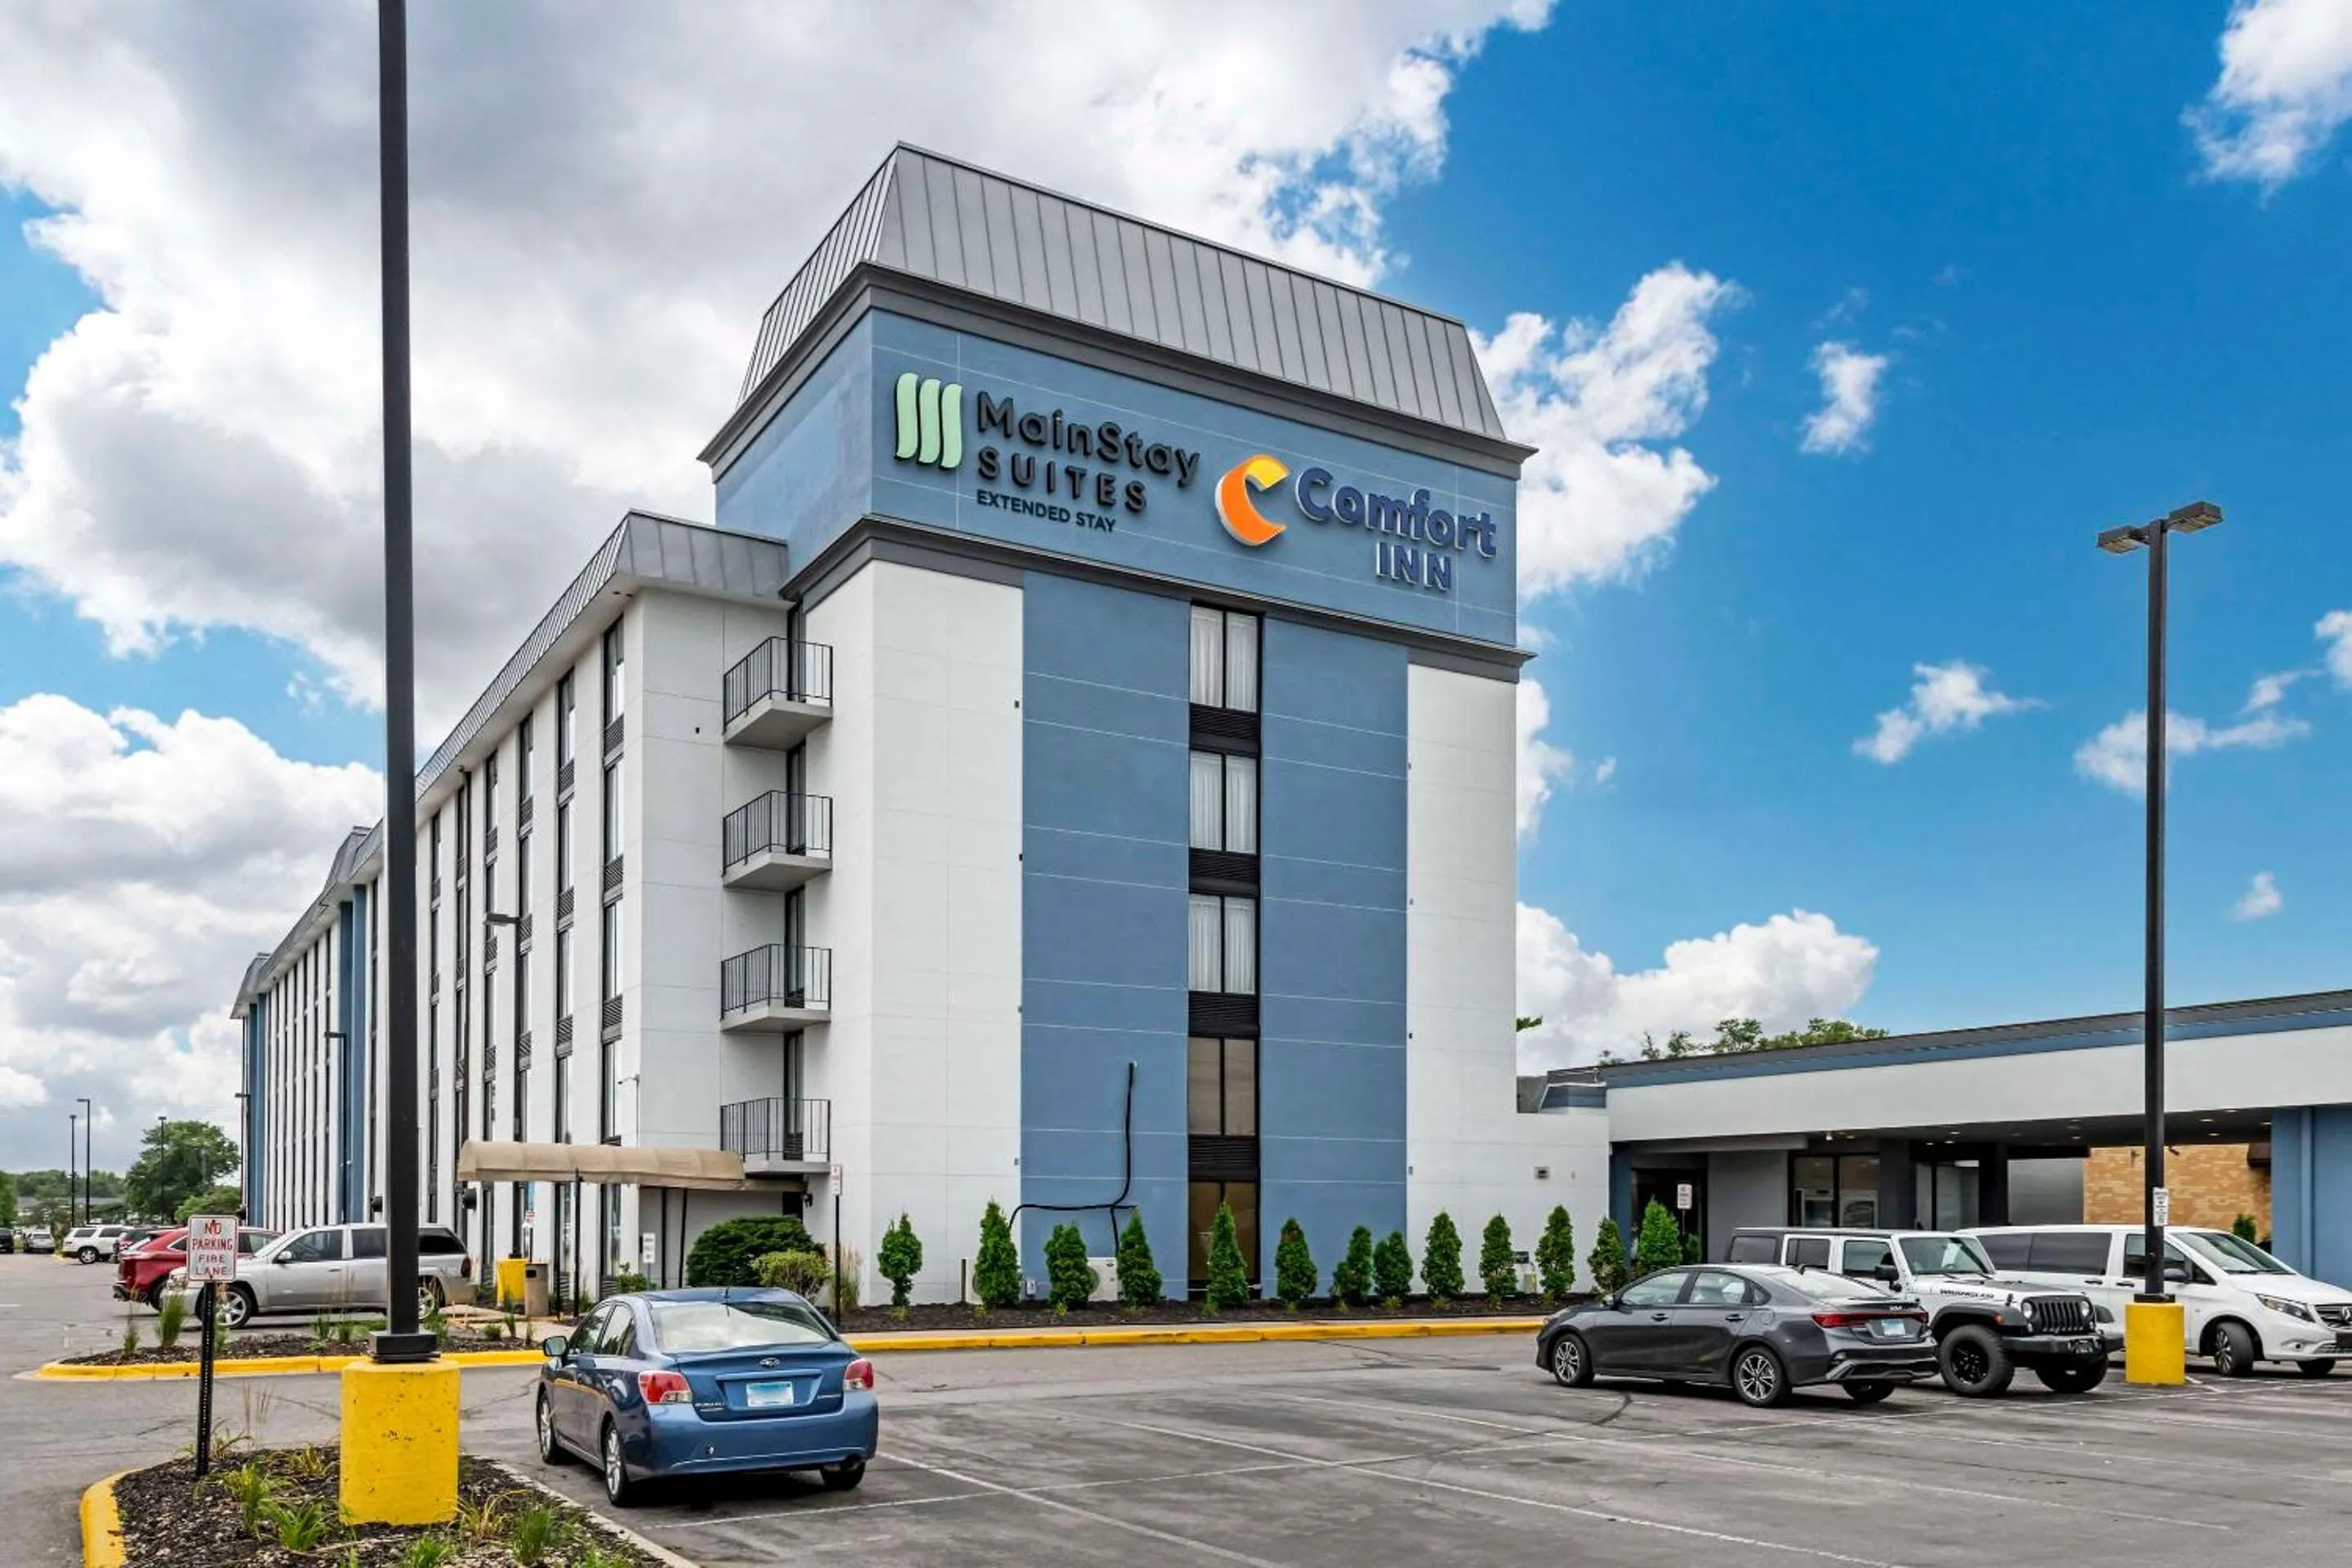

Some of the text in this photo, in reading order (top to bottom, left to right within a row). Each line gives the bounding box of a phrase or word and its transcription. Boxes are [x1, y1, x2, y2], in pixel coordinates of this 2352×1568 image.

[978, 391, 1200, 488] MainStay
[978, 445, 1147, 513] SUITES
[977, 488, 1116, 532] EXTENDED STAY
[1295, 467, 1497, 559] Comfort
[1376, 541, 1452, 591] INN
[192, 1238, 233, 1250] PARKING
[204, 1222, 222, 1235] NO
[195, 1267, 228, 1276] LANE
[198, 1254, 225, 1263] FIRE
